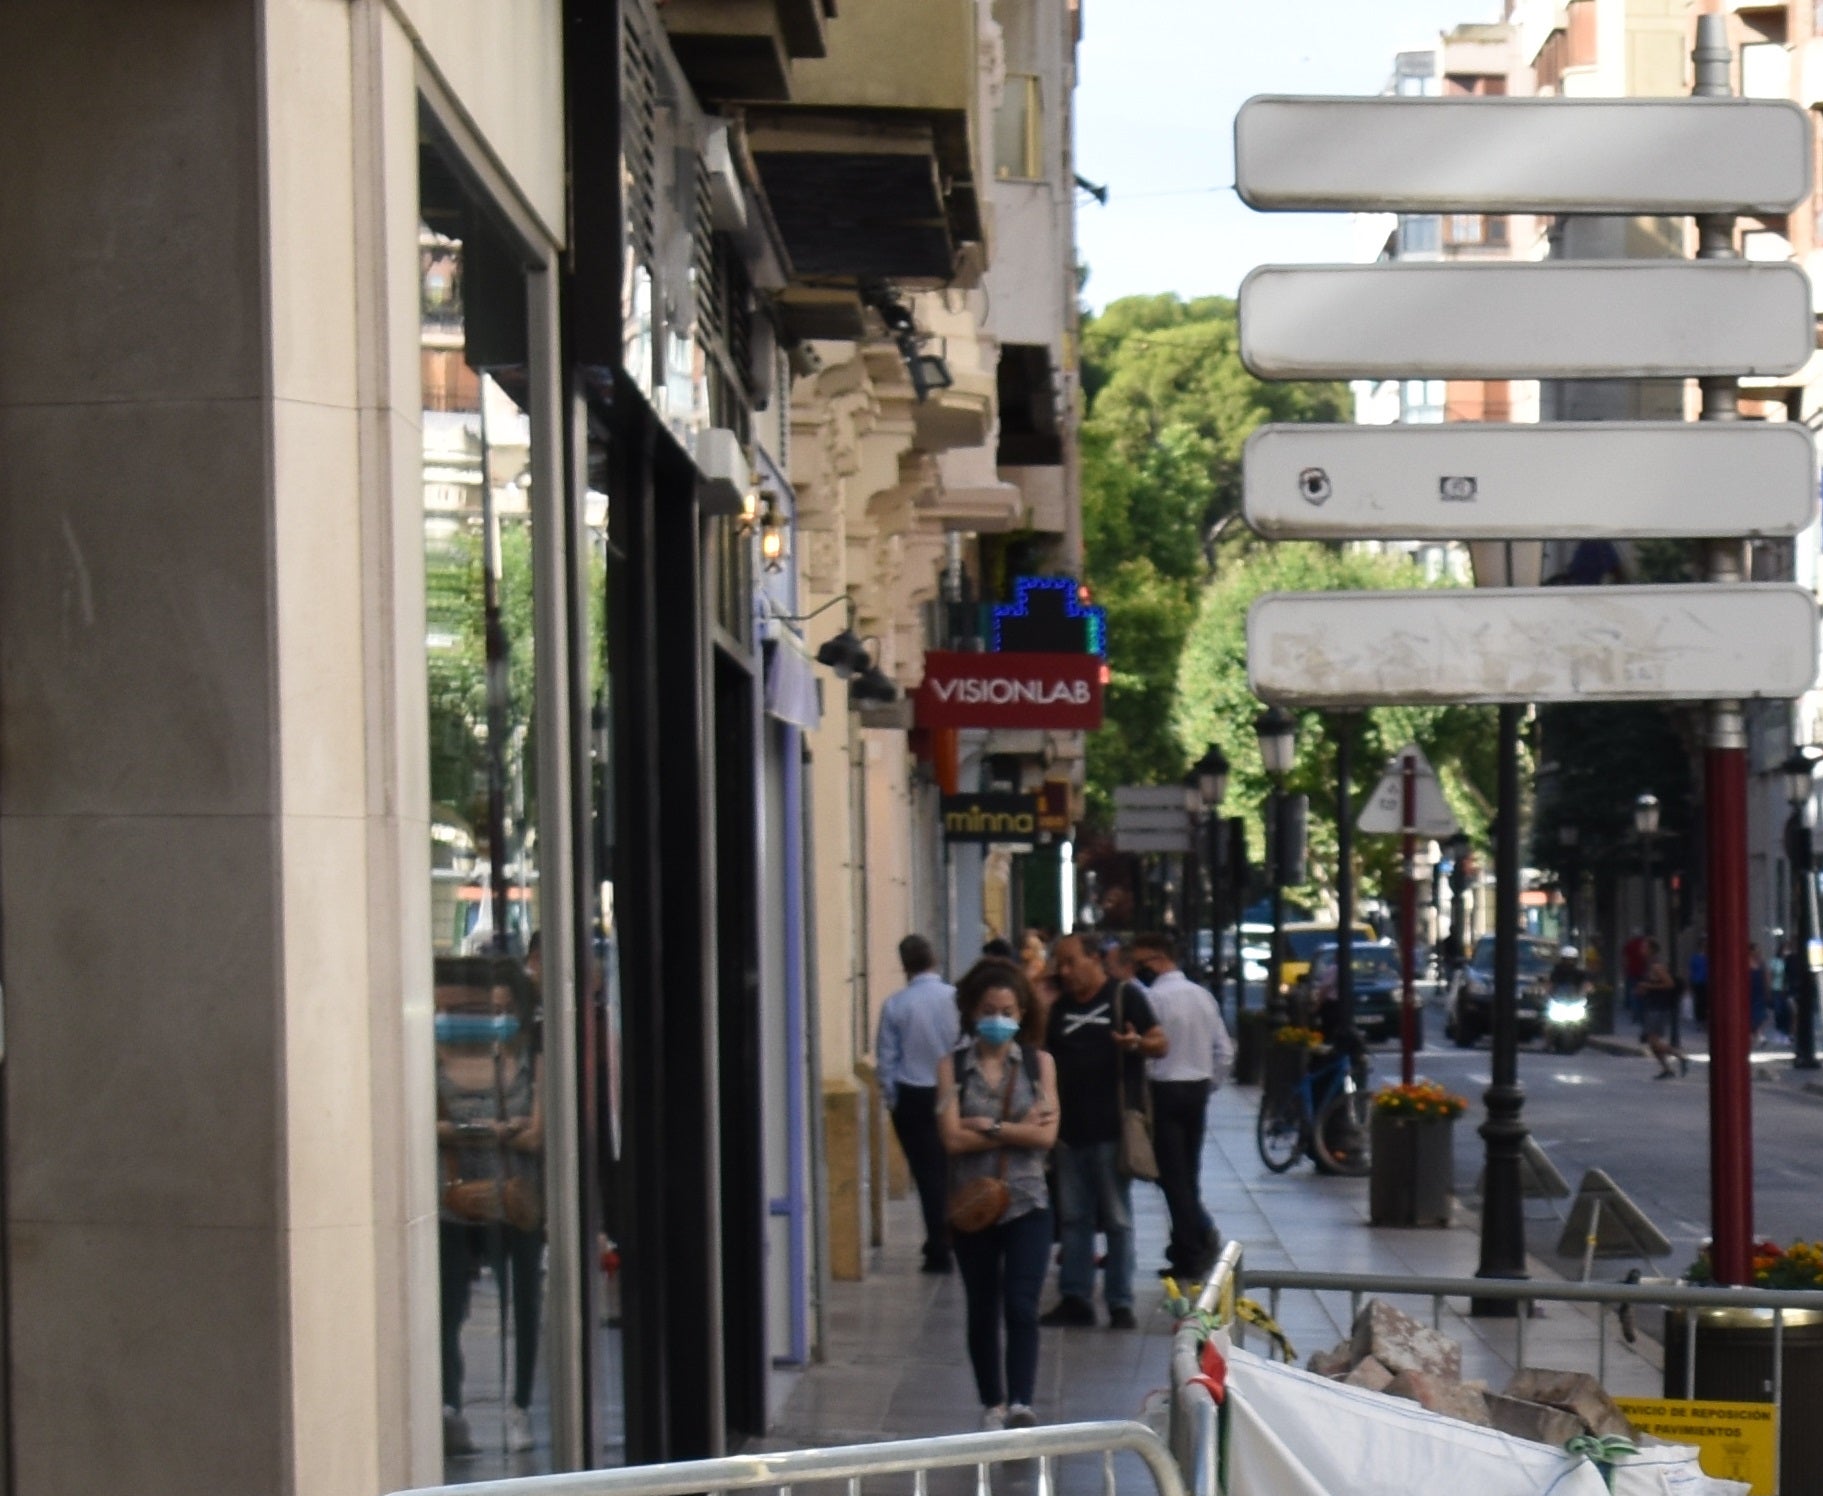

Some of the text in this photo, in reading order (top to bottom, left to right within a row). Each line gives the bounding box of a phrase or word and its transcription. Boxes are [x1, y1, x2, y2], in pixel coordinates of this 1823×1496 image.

[930, 678, 1091, 704] VISIONLAB
[946, 803, 1034, 834] minna
[1671, 1407, 1687, 1418] DE
[1655, 1424, 1742, 1438] PAVIMIENTOS
